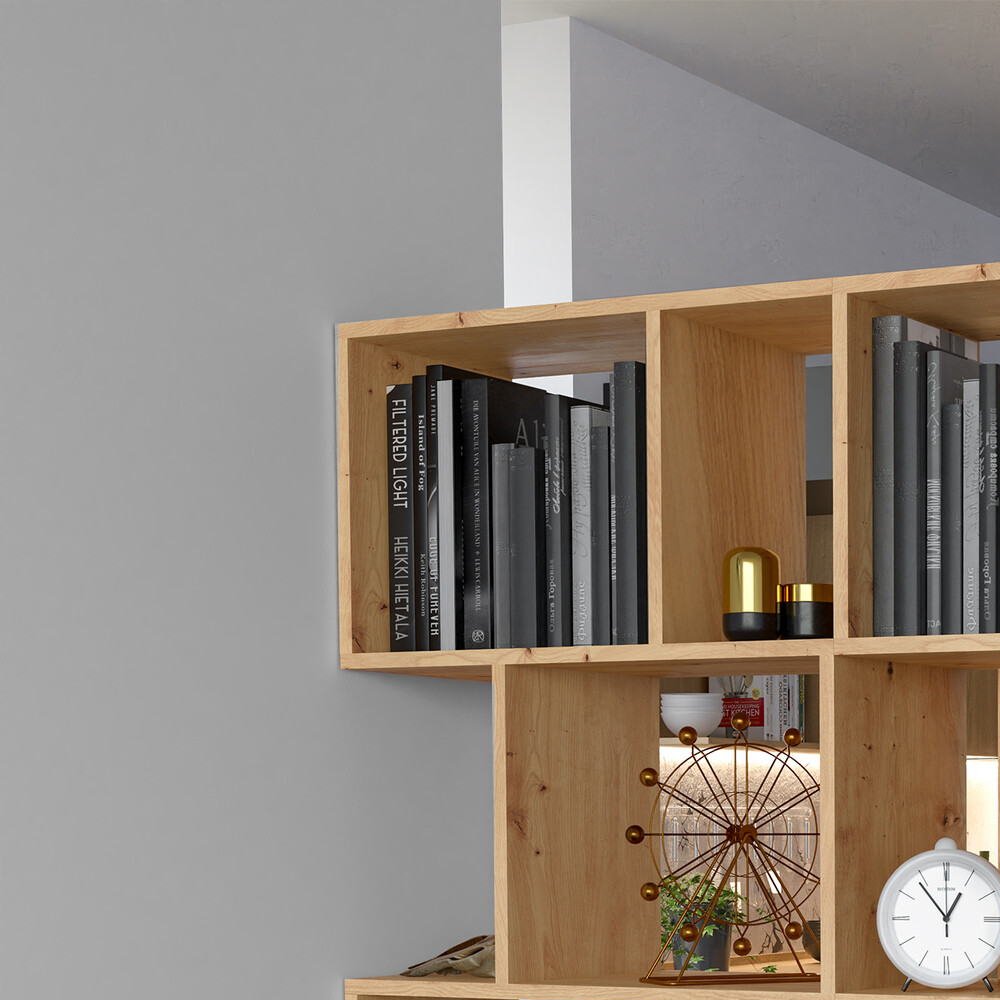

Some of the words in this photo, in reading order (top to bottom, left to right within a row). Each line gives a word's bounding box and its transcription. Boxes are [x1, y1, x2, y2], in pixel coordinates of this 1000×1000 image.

[392, 399, 408, 462] FILTERED
[417, 470, 425, 491] Fog
[418, 454, 426, 468] of
[392, 467, 408, 509] LIGHT
[474, 488, 480, 497] IN
[393, 537, 408, 579] HEIKKI
[394, 584, 409, 641] HIETALA
